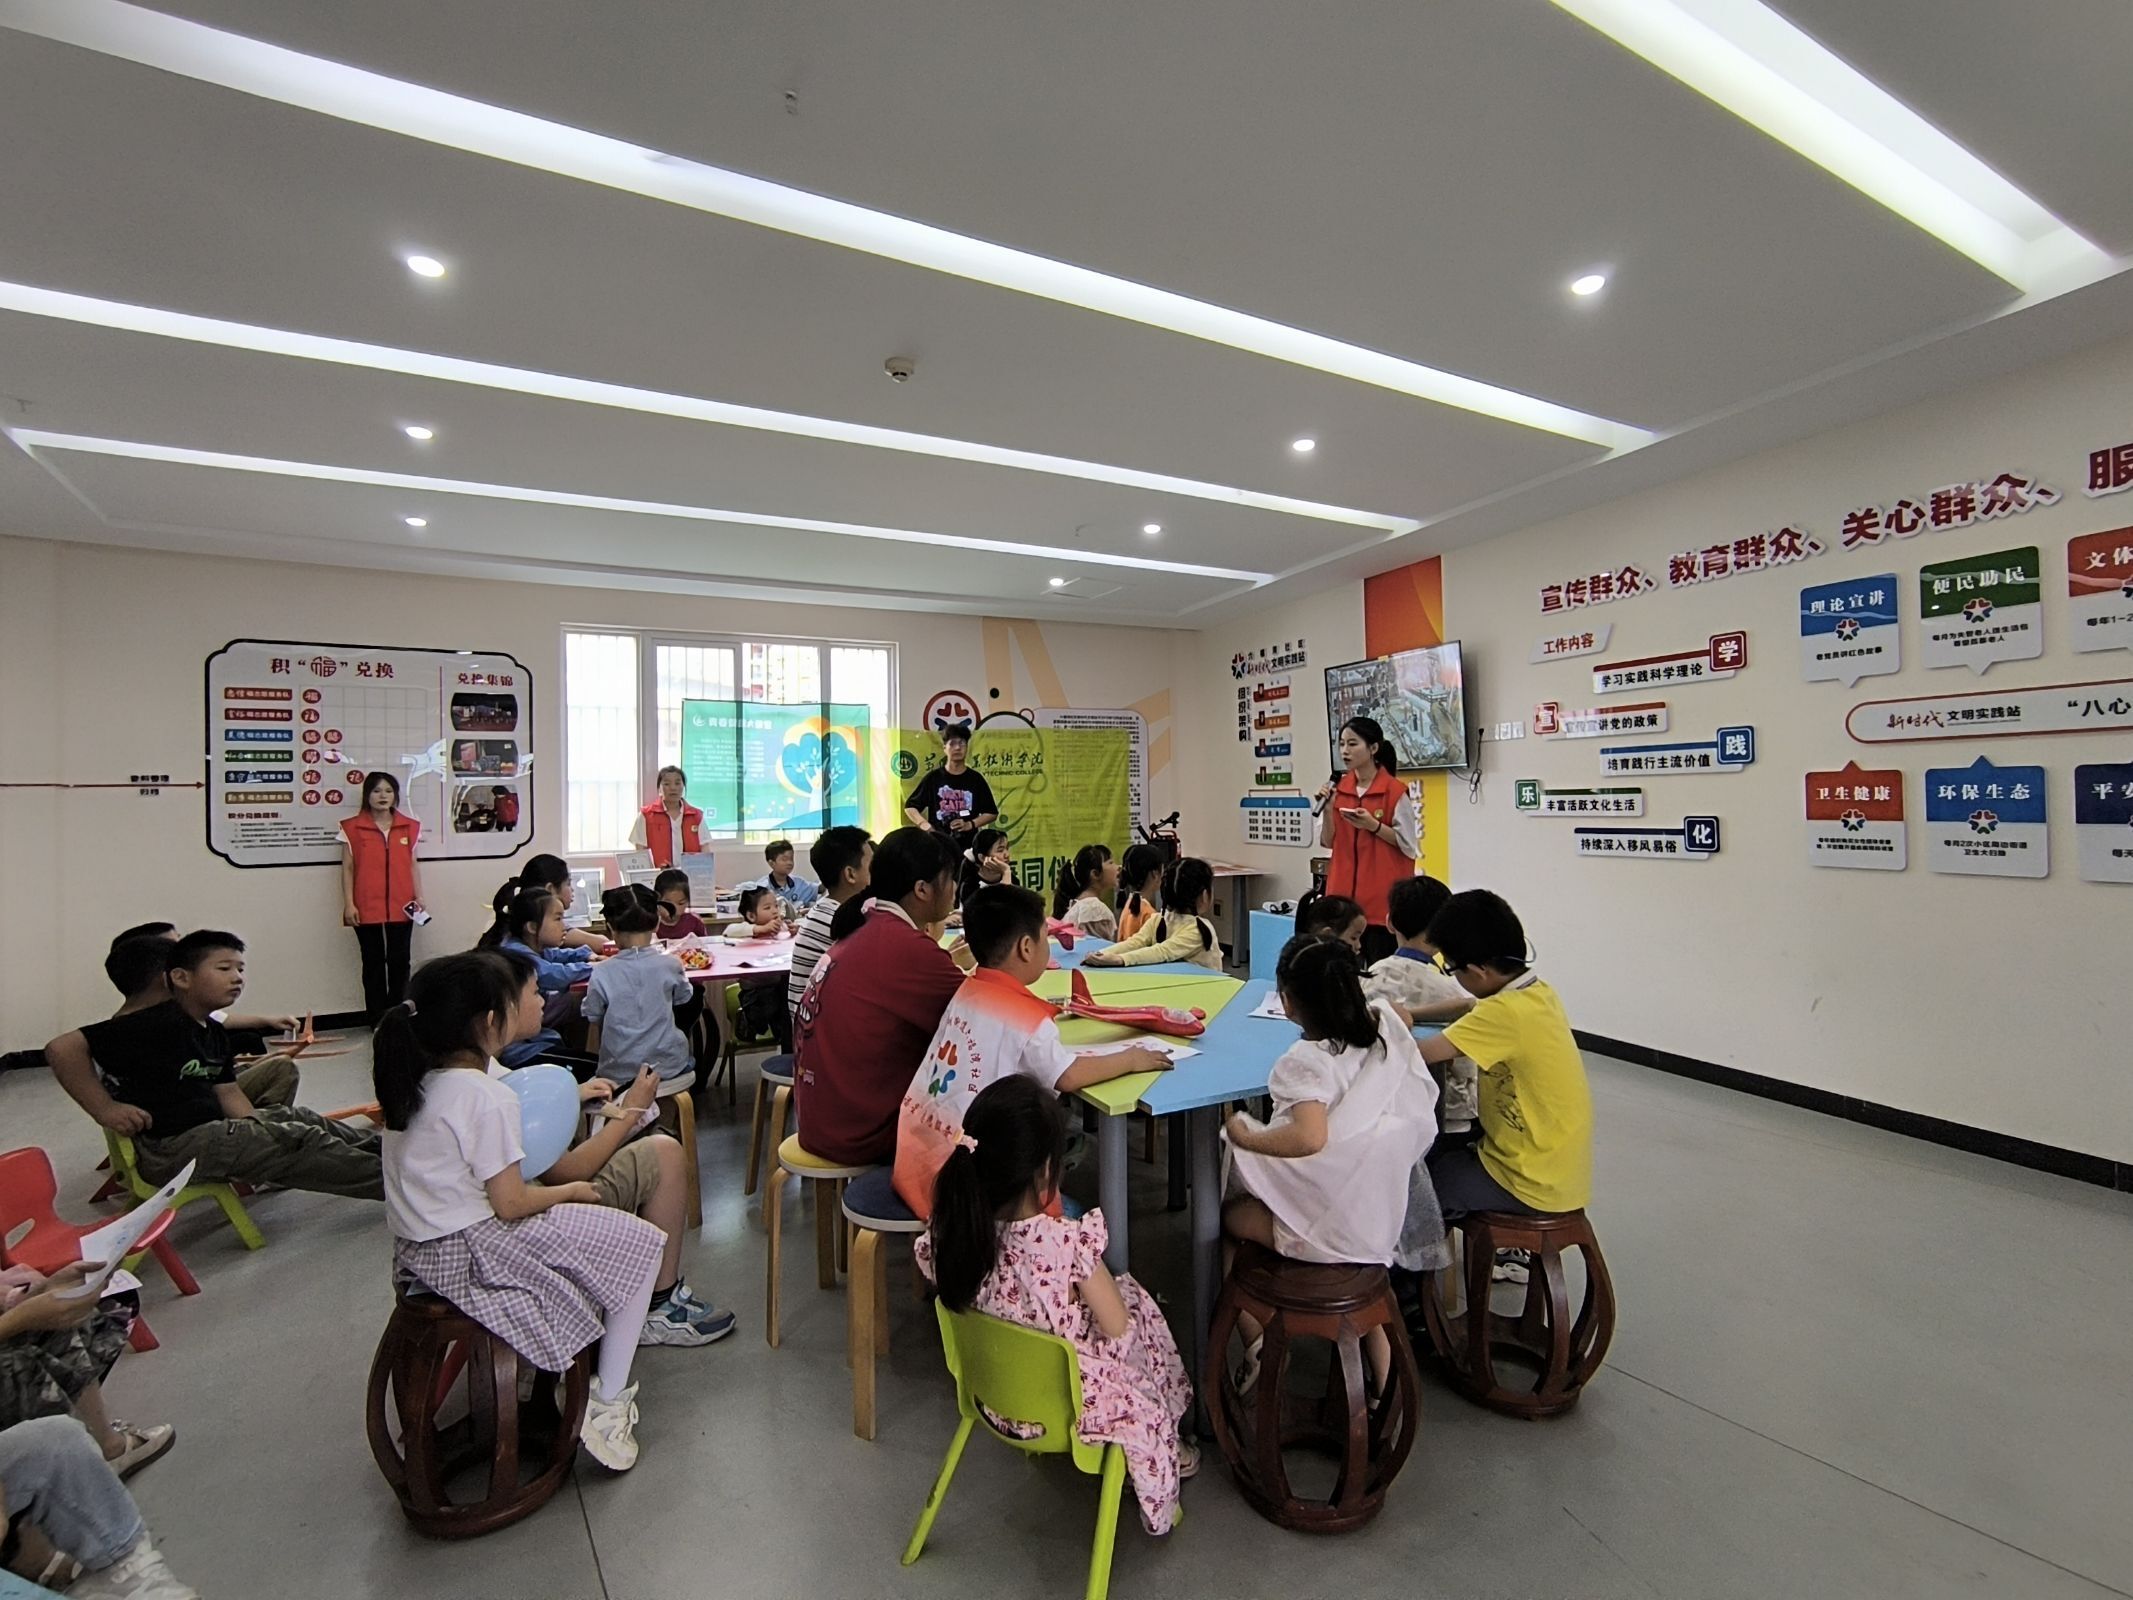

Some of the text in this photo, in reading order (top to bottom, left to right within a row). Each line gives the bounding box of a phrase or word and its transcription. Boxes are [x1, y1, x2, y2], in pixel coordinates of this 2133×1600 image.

[1541, 566, 1654, 612] 宣传群众、
[1669, 528, 1821, 584] 教育群众、
[1842, 472, 2054, 547] 关心群众、
[1933, 566, 2025, 595] 便民助民
[1810, 589, 1885, 614] 理论宣讲
[1543, 632, 1594, 655] 工作内容
[1718, 640, 1739, 662] 学
[1601, 662, 1703, 688] 学习实践科学理论
[1725, 734, 1747, 756] 践
[1607, 753, 1711, 771] 培育践行主流价值
[1521, 786, 1535, 803] 乐
[1816, 784, 1891, 801] 卫生健康
[1937, 783, 2031, 800] 环保生态
[1546, 799, 1636, 812] 丰富活跃文化生活
[1580, 837, 1678, 853] 持续深入移风易俗
[1691, 824, 1713, 845] 化
